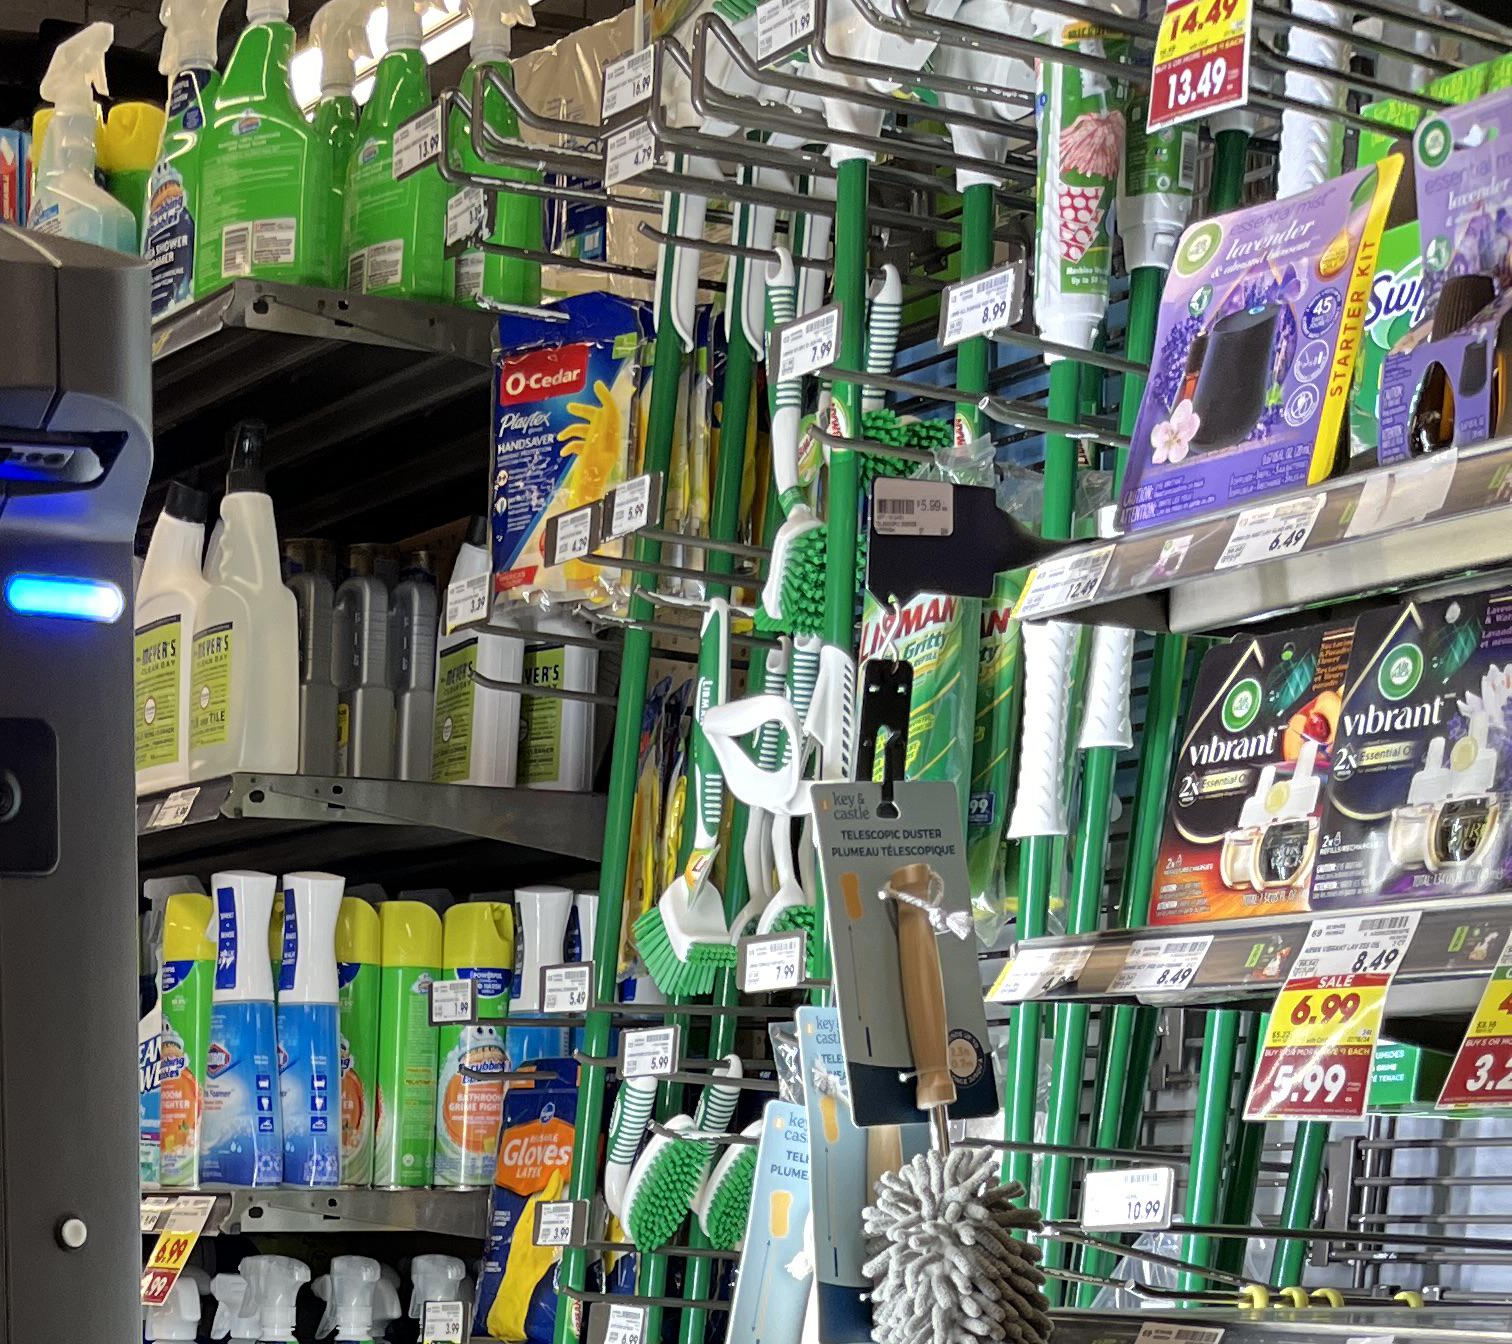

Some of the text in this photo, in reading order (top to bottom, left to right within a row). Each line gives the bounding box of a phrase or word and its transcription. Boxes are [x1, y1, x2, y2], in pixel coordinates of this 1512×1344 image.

[788, 12, 810, 32] 11.99
[1167, 57, 1227, 110] 13.49
[1225, 219, 1316, 262] lavender
[1355, 239, 1377, 280] KIT
[981, 300, 1007, 324] 8.99
[1313, 296, 1334, 316] 45
[810, 340, 833, 364] 7.99
[1329, 288, 1365, 399] STARTER
[506, 367, 582, 397] O-Cedar
[498, 411, 552, 438] Playtex
[497, 433, 555, 455] HANDSAVER
[627, 502, 645, 523] 5.99
[1269, 528, 1307, 552] 6.49
[142, 638, 177, 661] MEYER'S
[197, 634, 230, 659] MEYER'S
[903, 632, 947, 662] Gritty
[1343, 698, 1446, 737] vibrant
[1189, 728, 1277, 767] vibrant
[833, 790, 866, 809] key &
[833, 806, 870, 821] castle
[841, 828, 942, 842] TELESCOPIC DUSTER
[831, 843, 956, 858] PLUMEAU TÉLESCOPIQUE
[775, 962, 796, 981] 7.99
[1351, 947, 1400, 974] 8.49
[1155, 965, 1193, 986] 8.49
[1316, 973, 1354, 990] SALE
[569, 989, 587, 1007] 5.49
[1289, 991, 1362, 1026] 6.99
[650, 1055, 670, 1072] 5.99
[1269, 1062, 1348, 1104] 5.99
[503, 1138, 573, 1168] Gloves
[516, 1165, 543, 1179] LATEX
[1125, 1199, 1161, 1221] 10.99
[552, 1225, 570, 1242] 3.99
[155, 1238, 189, 1265] 6.99
[445, 1321, 464, 1337] 3.99
